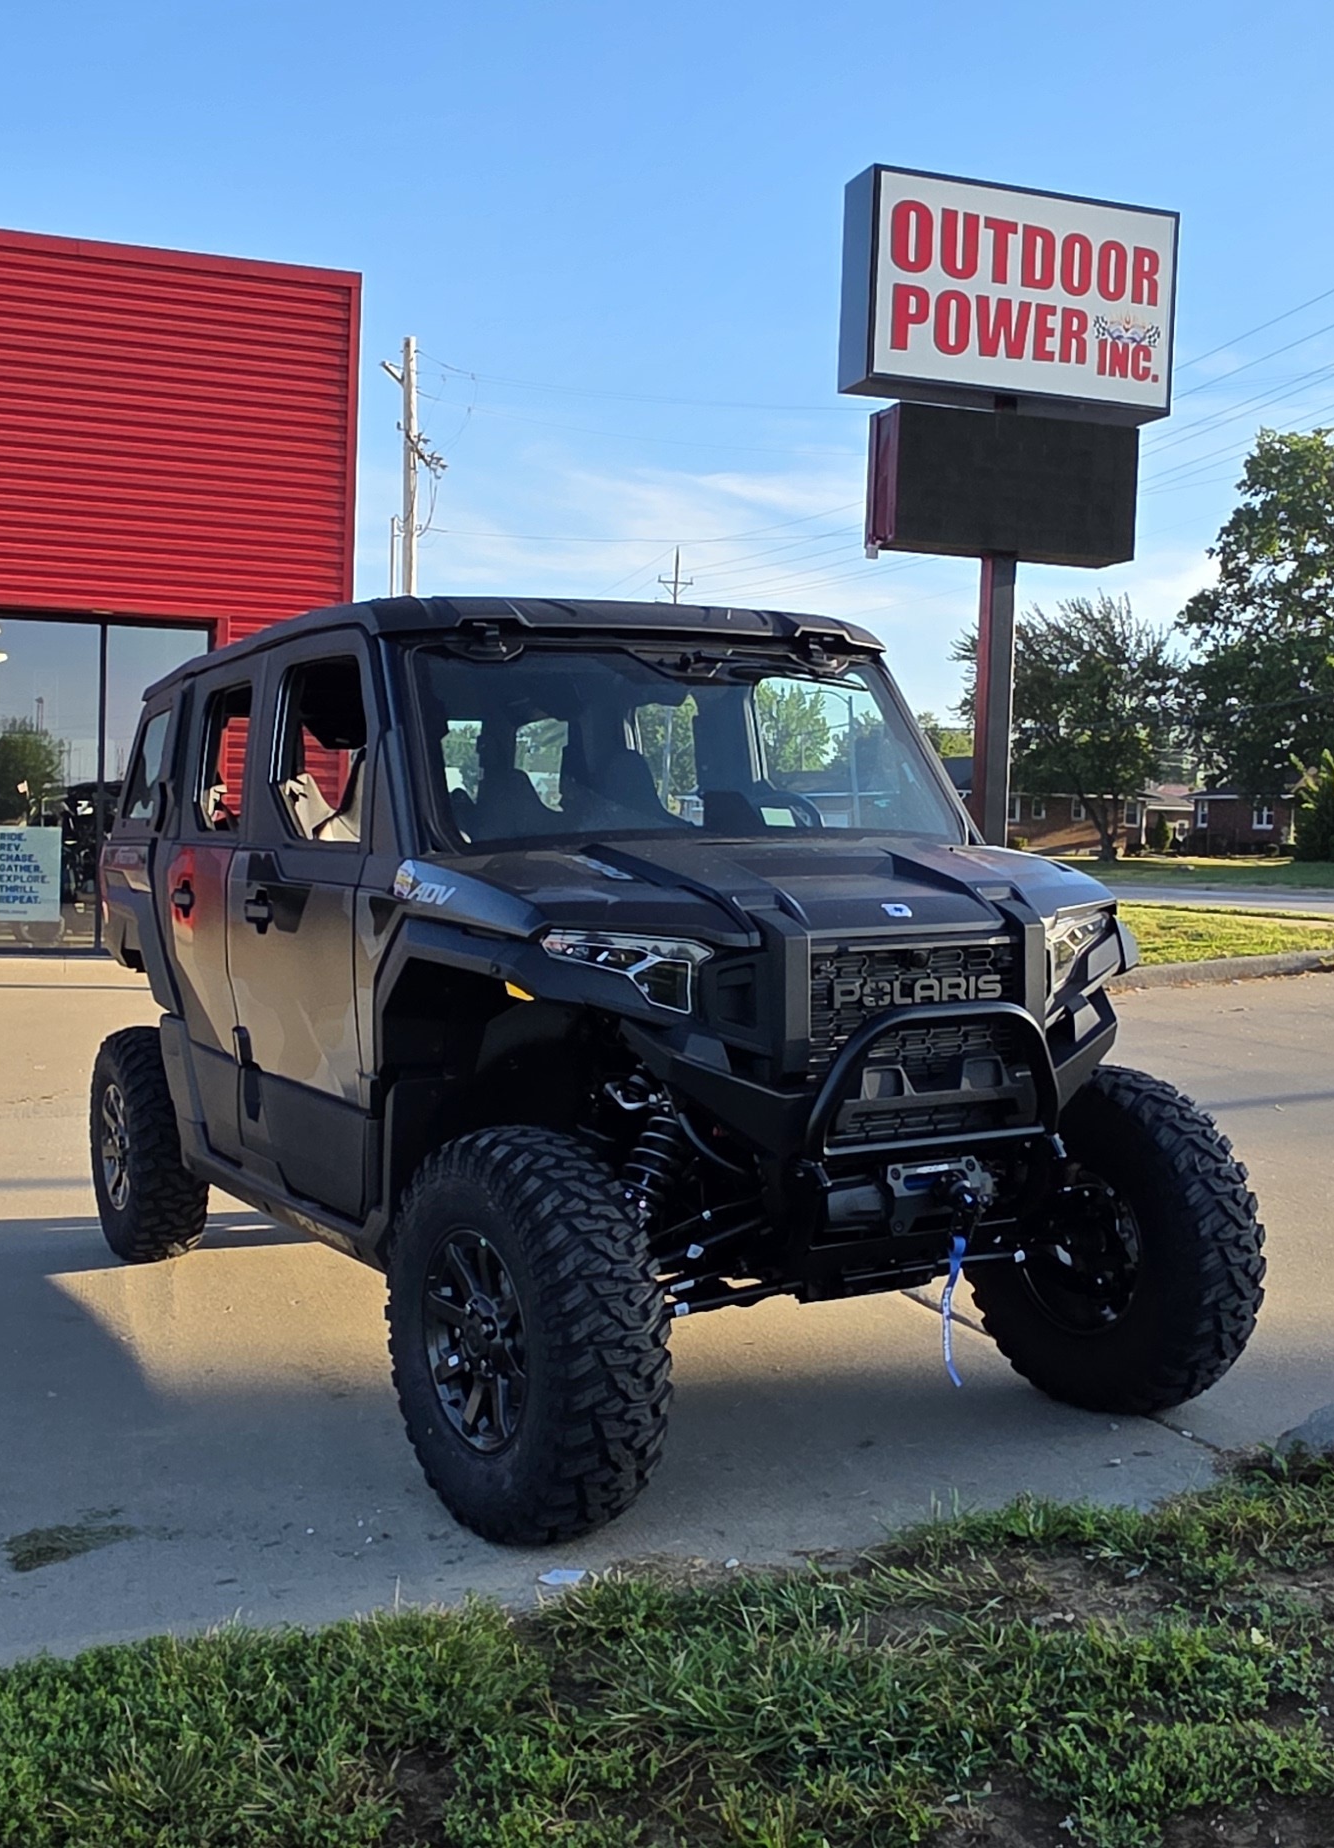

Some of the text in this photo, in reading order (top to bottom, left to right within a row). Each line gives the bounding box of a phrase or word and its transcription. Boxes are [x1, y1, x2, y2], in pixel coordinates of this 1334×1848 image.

[889, 199, 1160, 307] OUTDOOR
[889, 282, 1088, 366] POWER
[1096, 338, 1160, 383] INC.
[0, 832, 27, 842] RIDE.
[0, 843, 24, 852] REV.
[0, 853, 38, 863] CHASE.
[407, 882, 457, 905] ADV
[833, 974, 1003, 1010] POLARIS
